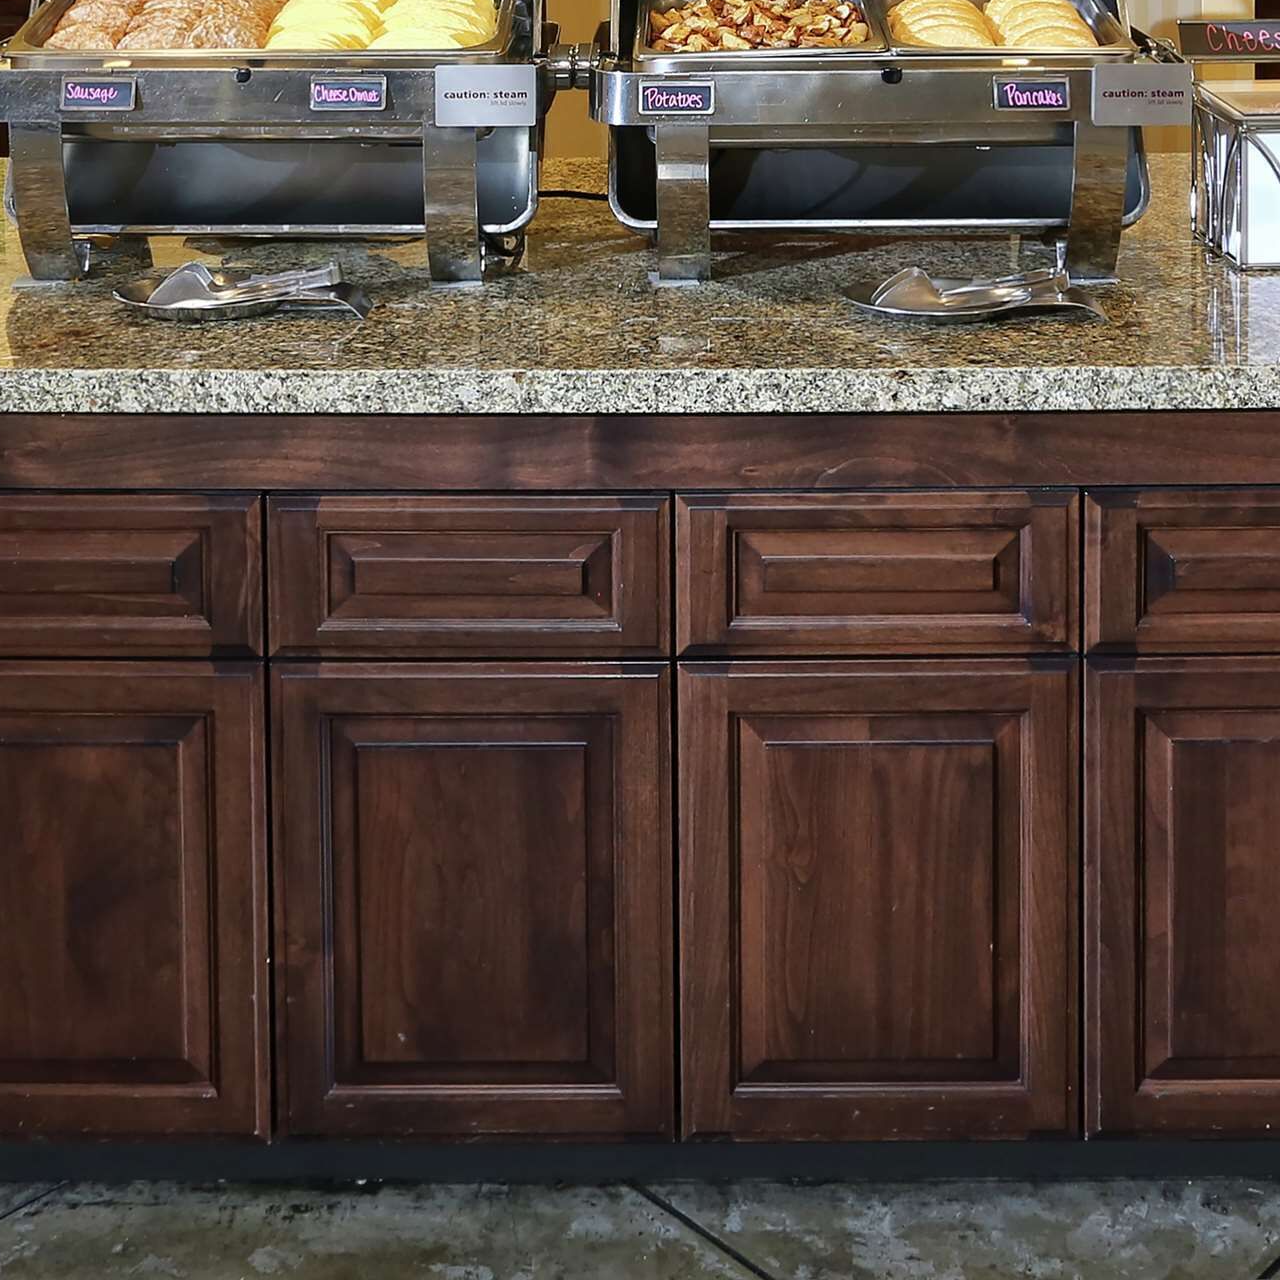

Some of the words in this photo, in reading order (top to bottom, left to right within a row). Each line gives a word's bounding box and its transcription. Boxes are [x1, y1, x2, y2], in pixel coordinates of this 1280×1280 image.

[66, 83, 118, 103] Sausage
[314, 84, 349, 102] Cheese
[444, 90, 490, 99] caution:
[493, 91, 528, 99] steam
[644, 87, 703, 109] Potatoes
[1003, 83, 1063, 106] Pancakes
[1102, 89, 1148, 98] caution:
[1151, 90, 1185, 98] steam
